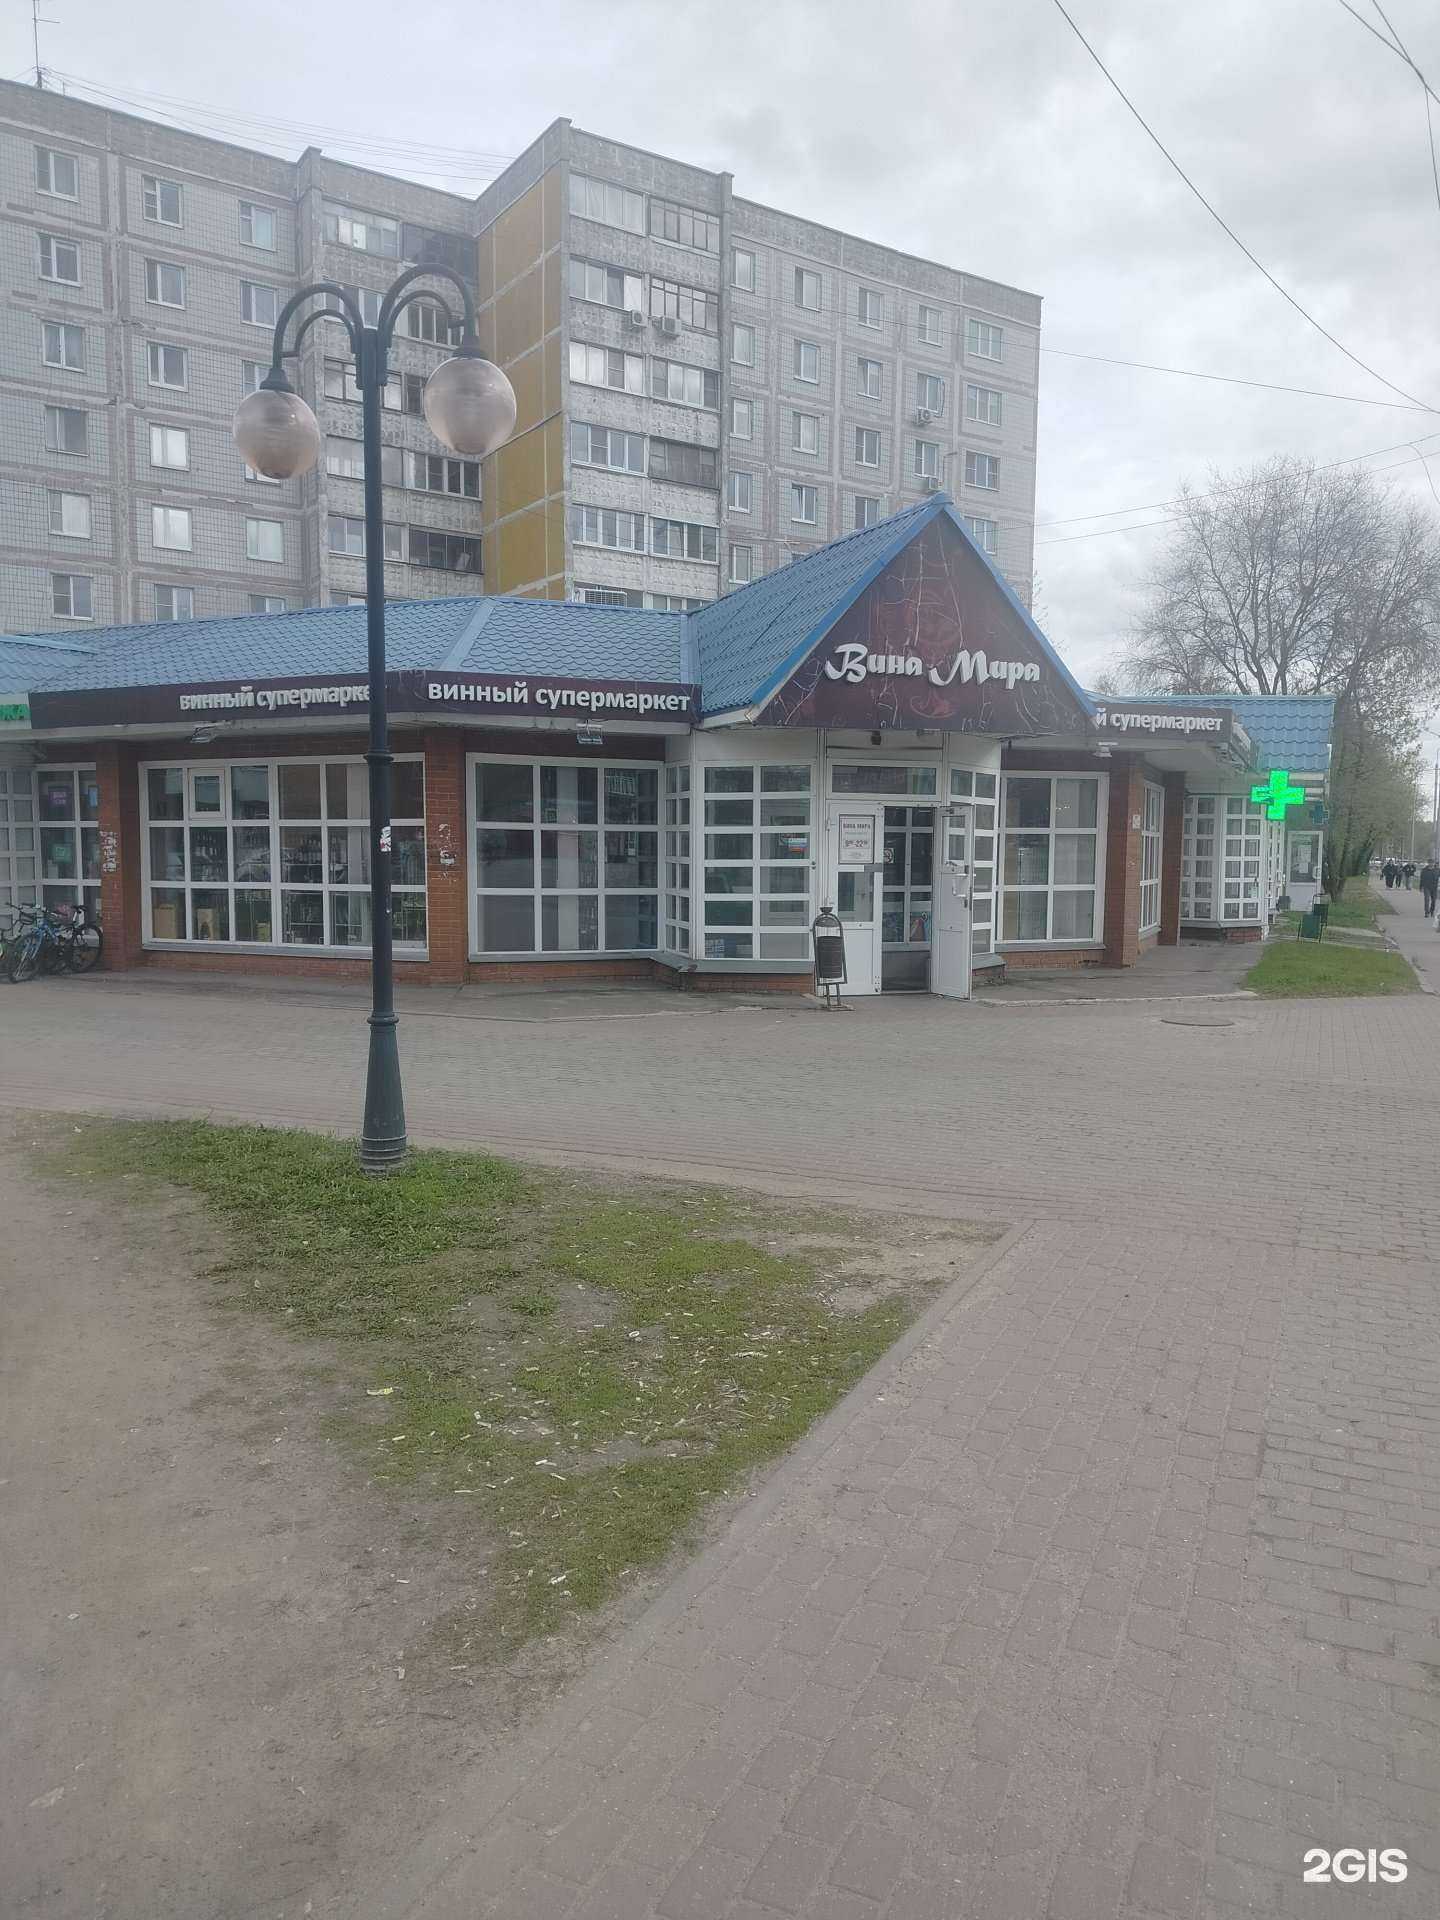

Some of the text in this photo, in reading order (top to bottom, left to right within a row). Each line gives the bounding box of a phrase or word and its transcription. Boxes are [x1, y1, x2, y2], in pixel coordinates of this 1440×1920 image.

[824, 642, 1041, 690] Вина Мира
[179, 684, 371, 712] винный супермарке
[428, 681, 691, 714] винный супермаркет
[1109, 711, 1224, 734] супермаркет
